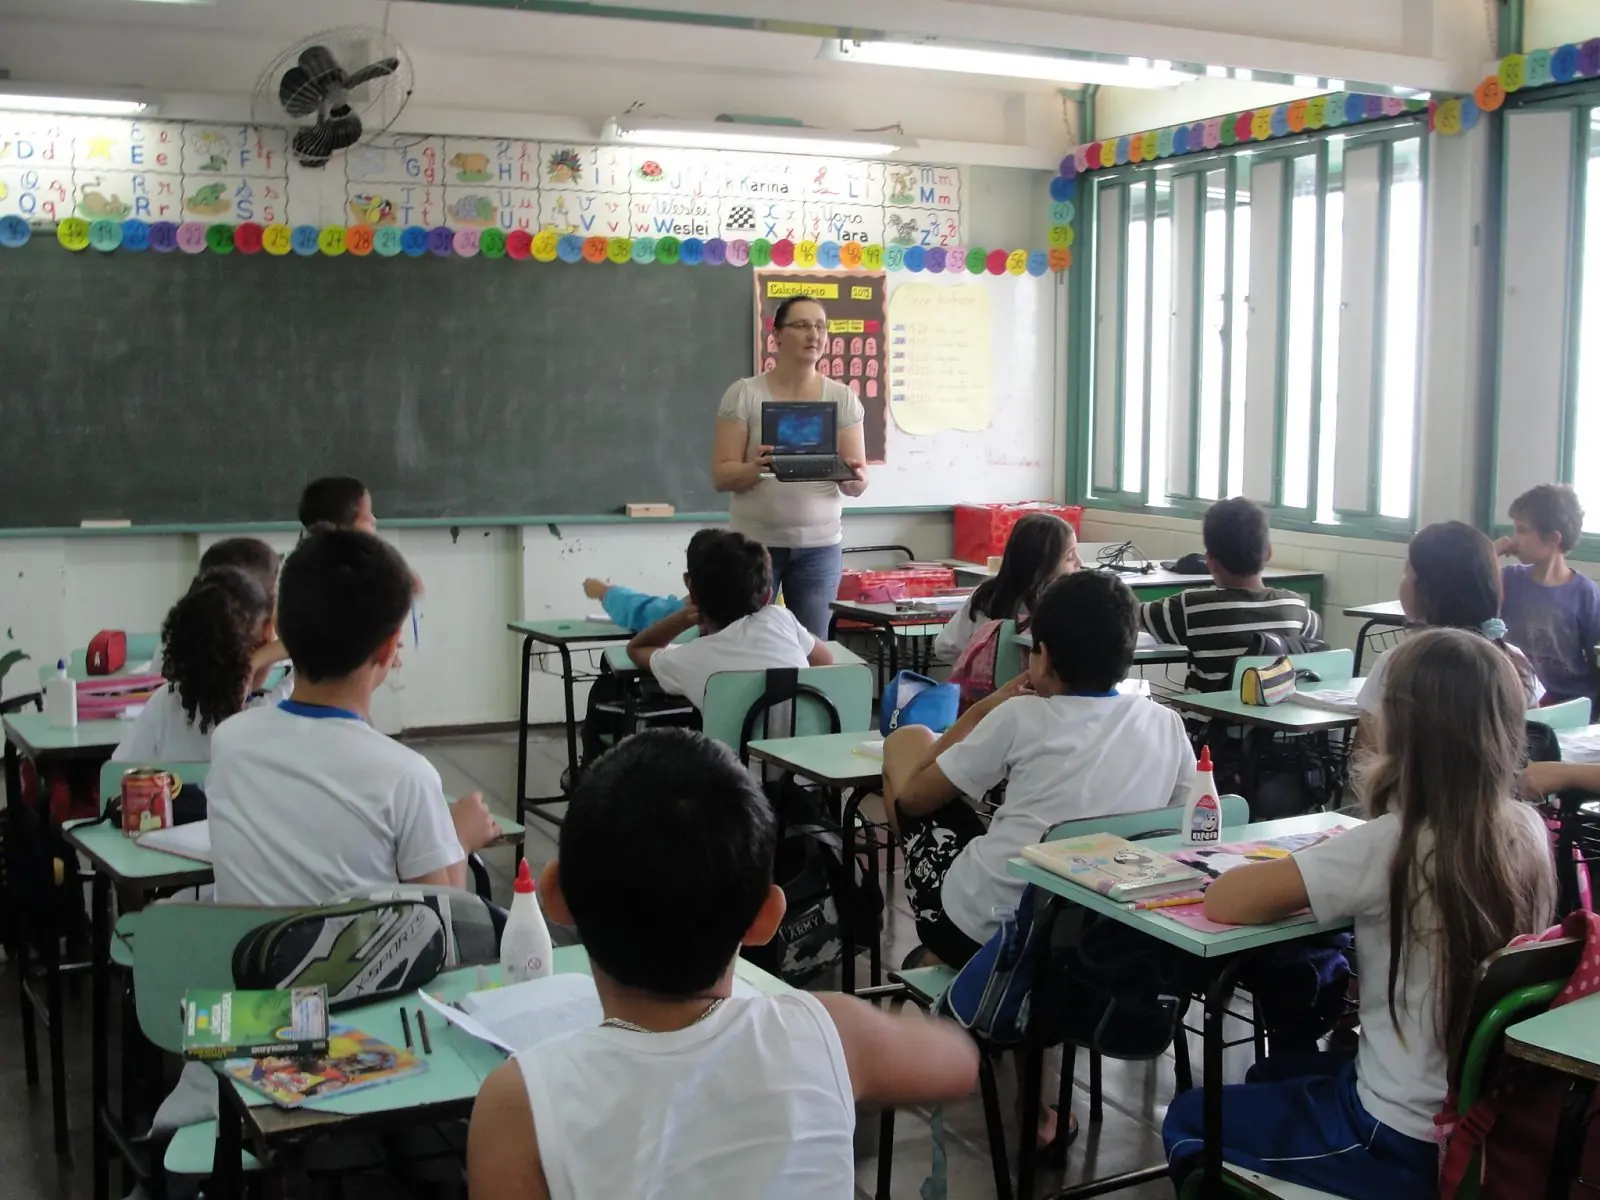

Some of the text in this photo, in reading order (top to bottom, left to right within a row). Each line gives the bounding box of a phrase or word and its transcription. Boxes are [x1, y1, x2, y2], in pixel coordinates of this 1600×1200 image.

[17, 140, 54, 160] D d
[130, 145, 168, 166] E e
[239, 150, 252, 169] F
[405, 157, 436, 184] G g
[498, 163, 530, 182] H h
[740, 173, 789, 194] Karina
[848, 181, 860, 199] L
[919, 186, 951, 206] M m
[42, 200, 55, 221] q
[135, 196, 170, 217] R r
[236, 199, 276, 222] S s
[400, 207, 430, 226] T t
[499, 211, 530, 229] U u
[580, 214, 619, 232] V v
[635, 216, 710, 236] w Weslei
[764, 221, 779, 239] X
[833, 222, 869, 243] Yara
[919, 229, 950, 247] Z z
[353, 229, 370, 249] 28
[865, 247, 880, 265] 49
[887, 250, 902, 268] 50
